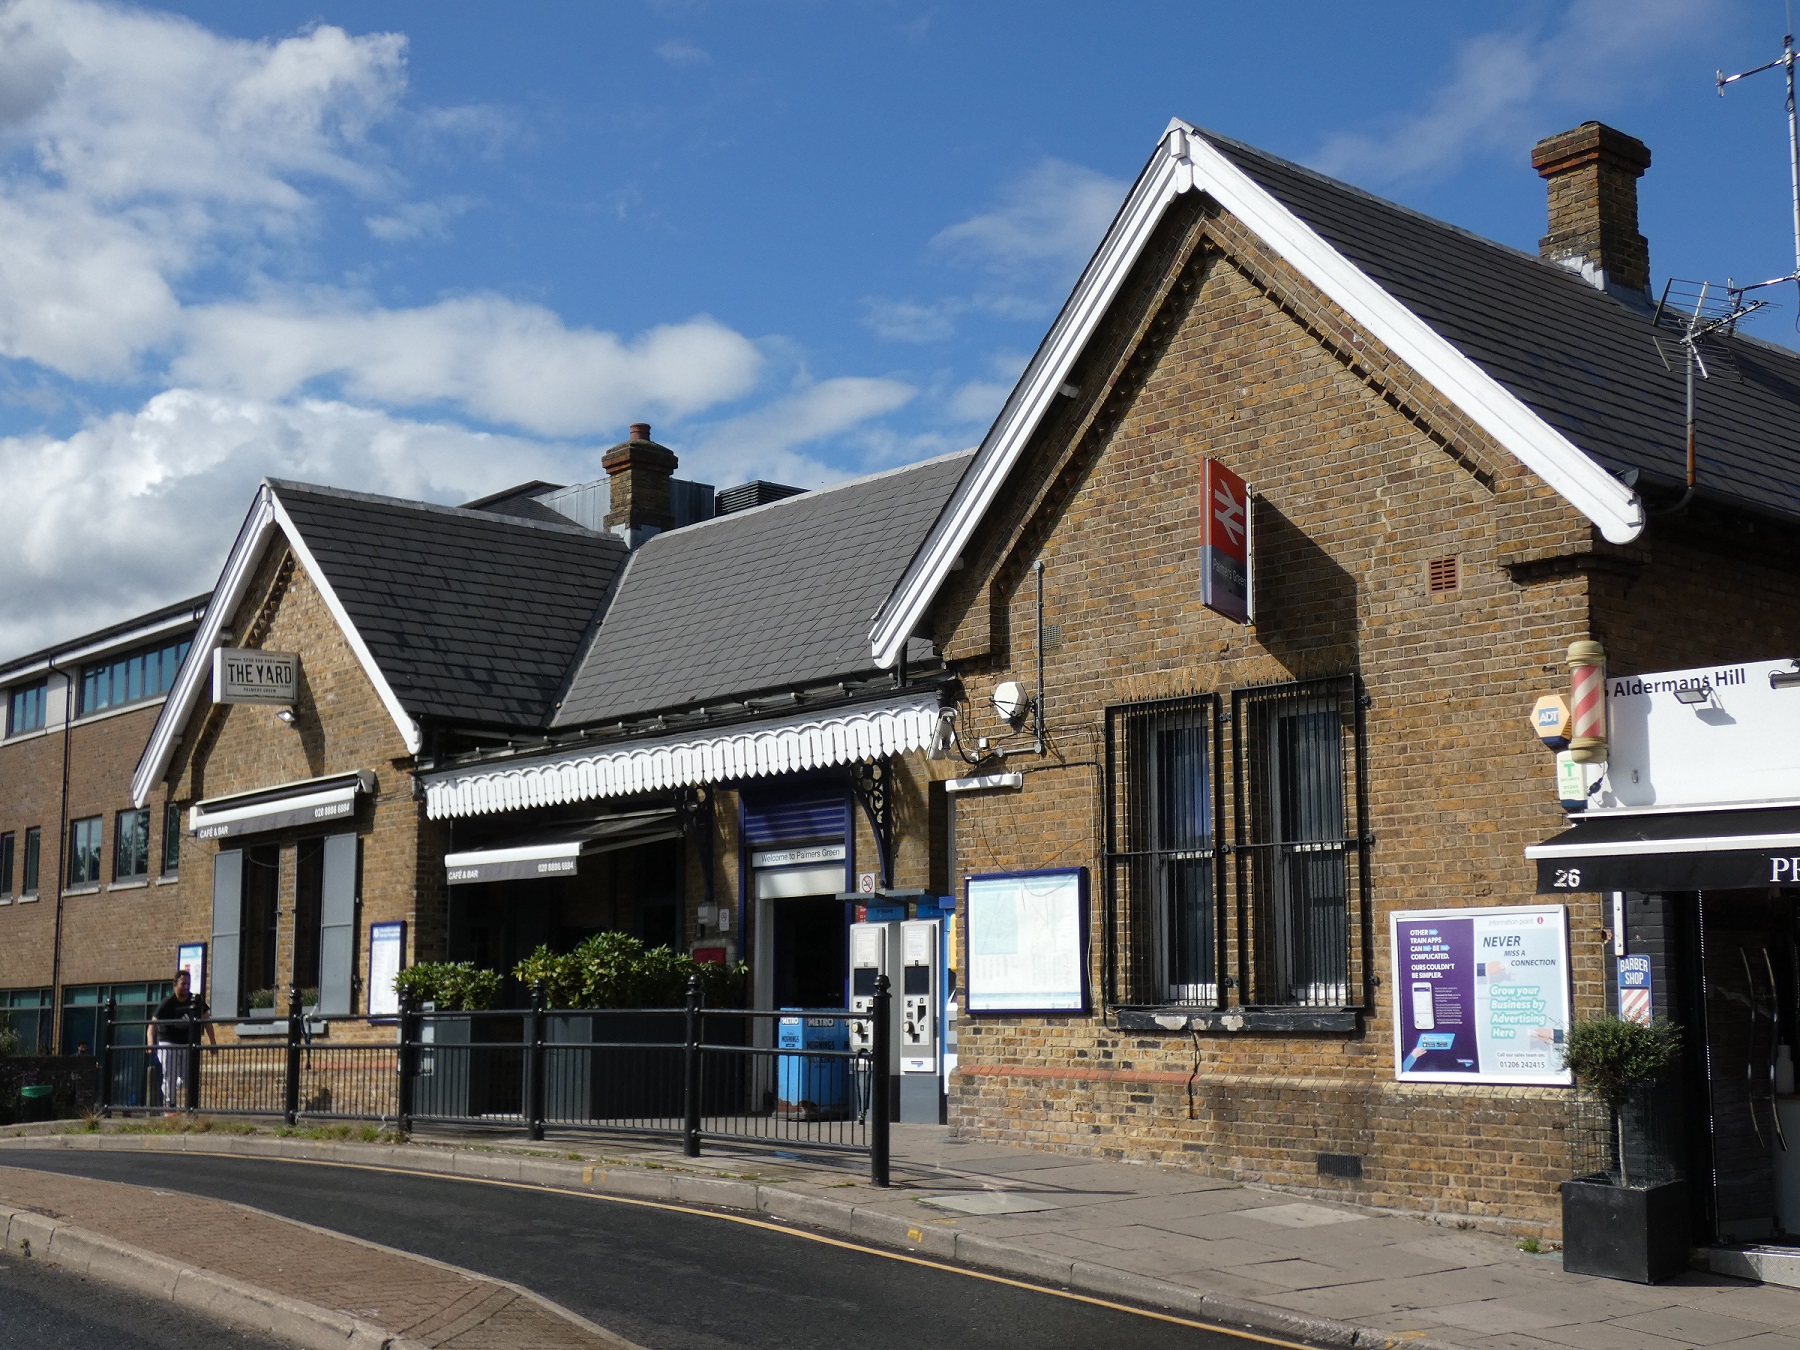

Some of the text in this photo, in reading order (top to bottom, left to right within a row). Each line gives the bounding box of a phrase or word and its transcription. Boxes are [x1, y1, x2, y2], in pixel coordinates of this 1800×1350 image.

[1213, 557, 1247, 588] Palmers Green
[228, 664, 292, 684] THE YARD
[1613, 676, 1710, 697] Aldermans
[1715, 668, 1746, 687] Hill
[1539, 710, 1559, 723] ADT
[199, 828, 213, 839] CAFÉ
[217, 825, 229, 836] BAR
[761, 848, 840, 862] Welcome to Palmers Green
[448, 869, 463, 880] CAFÉ
[466, 869, 479, 878] BAR
[1553, 868, 1581, 888] 26
[1488, 917, 1534, 926] information point
[1482, 935, 1521, 948] NEVER
[1520, 949, 1526, 957] A
[1510, 959, 1557, 967] CONNECTION
[1620, 958, 1649, 973] BARBER
[1625, 972, 1644, 984] SHOP
[1490, 985, 1539, 998] Grow your
[1490, 999, 1545, 1012] Business by
[782, 1017, 799, 1025] METRO
[807, 1018, 834, 1027] METRO
[1491, 1013, 1546, 1026] Advertising
[1492, 1027, 1515, 1038] Here
